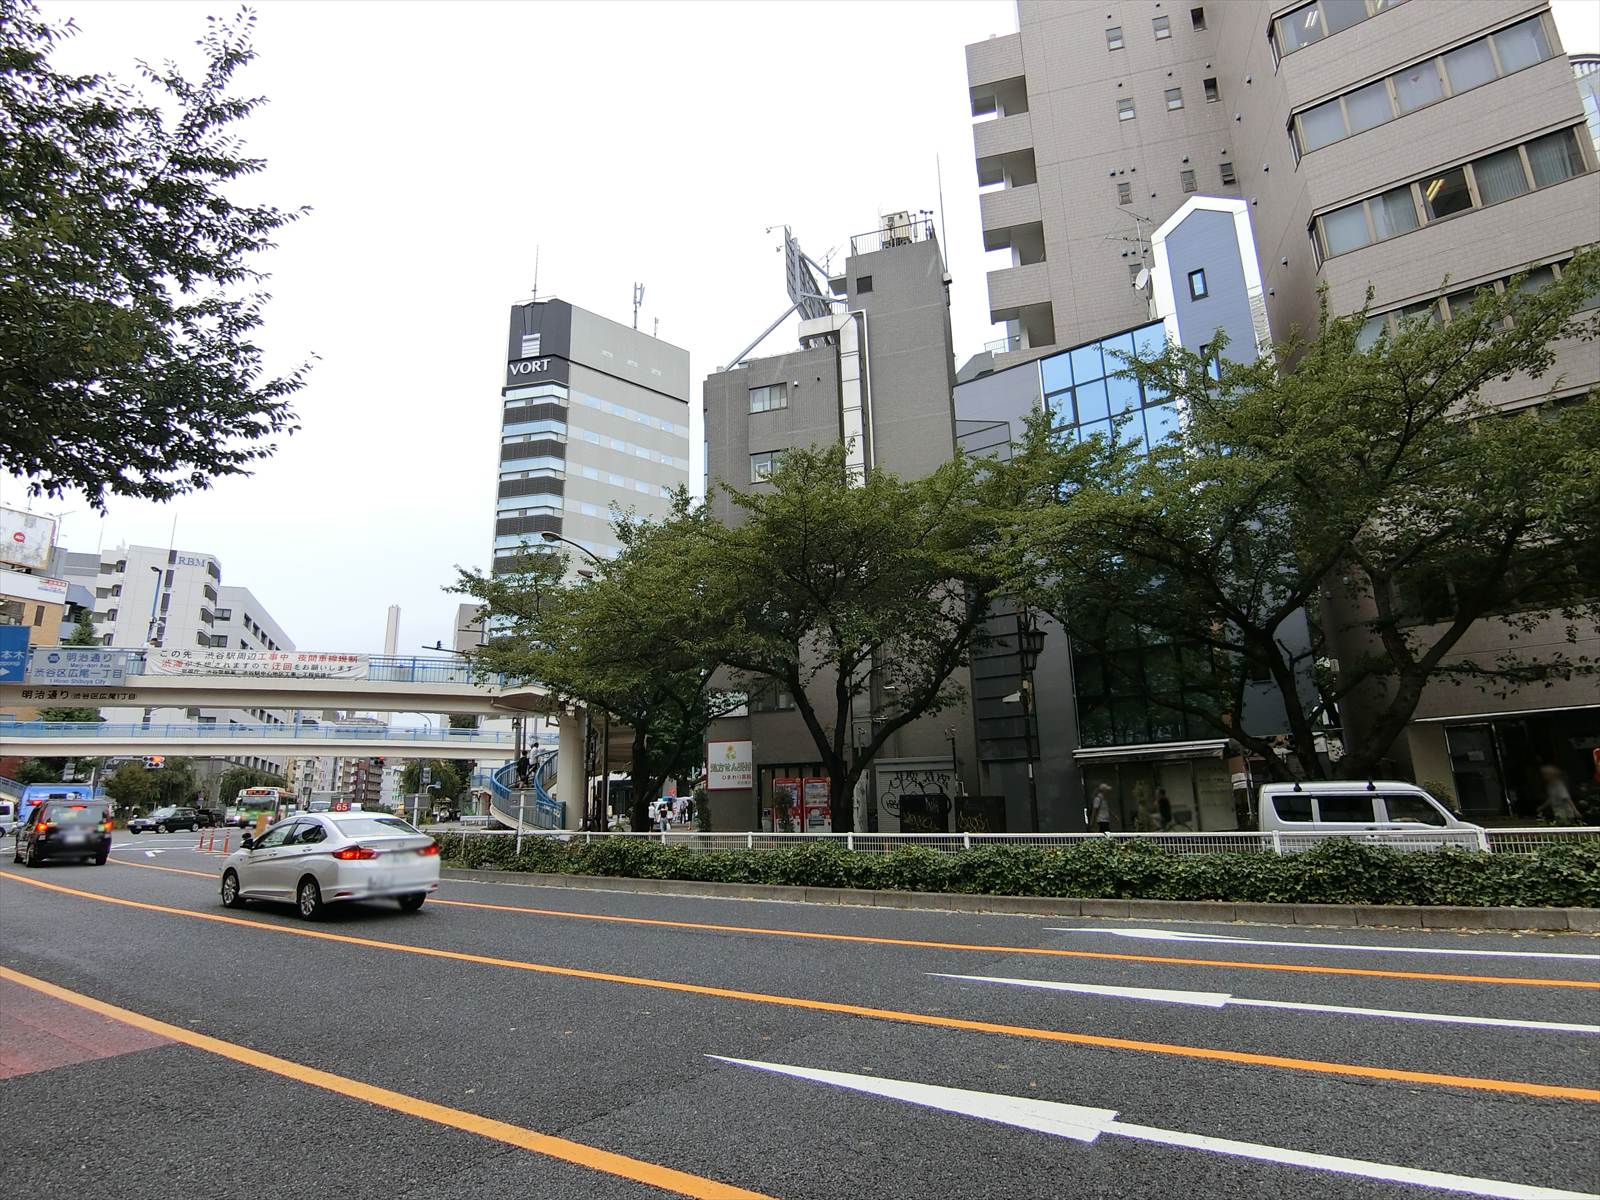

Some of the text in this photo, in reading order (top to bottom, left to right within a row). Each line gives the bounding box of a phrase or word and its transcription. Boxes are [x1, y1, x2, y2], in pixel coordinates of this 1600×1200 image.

[509, 358, 552, 376] VORT
[177, 556, 206, 567] RBM
[66, 652, 112, 663] 明治通り
[160, 650, 192, 659] この先
[34, 668, 123, 678] 渋谷区広尾一丁目
[22, 689, 69, 700] 明治通り
[336, 803, 348, 811] 65
